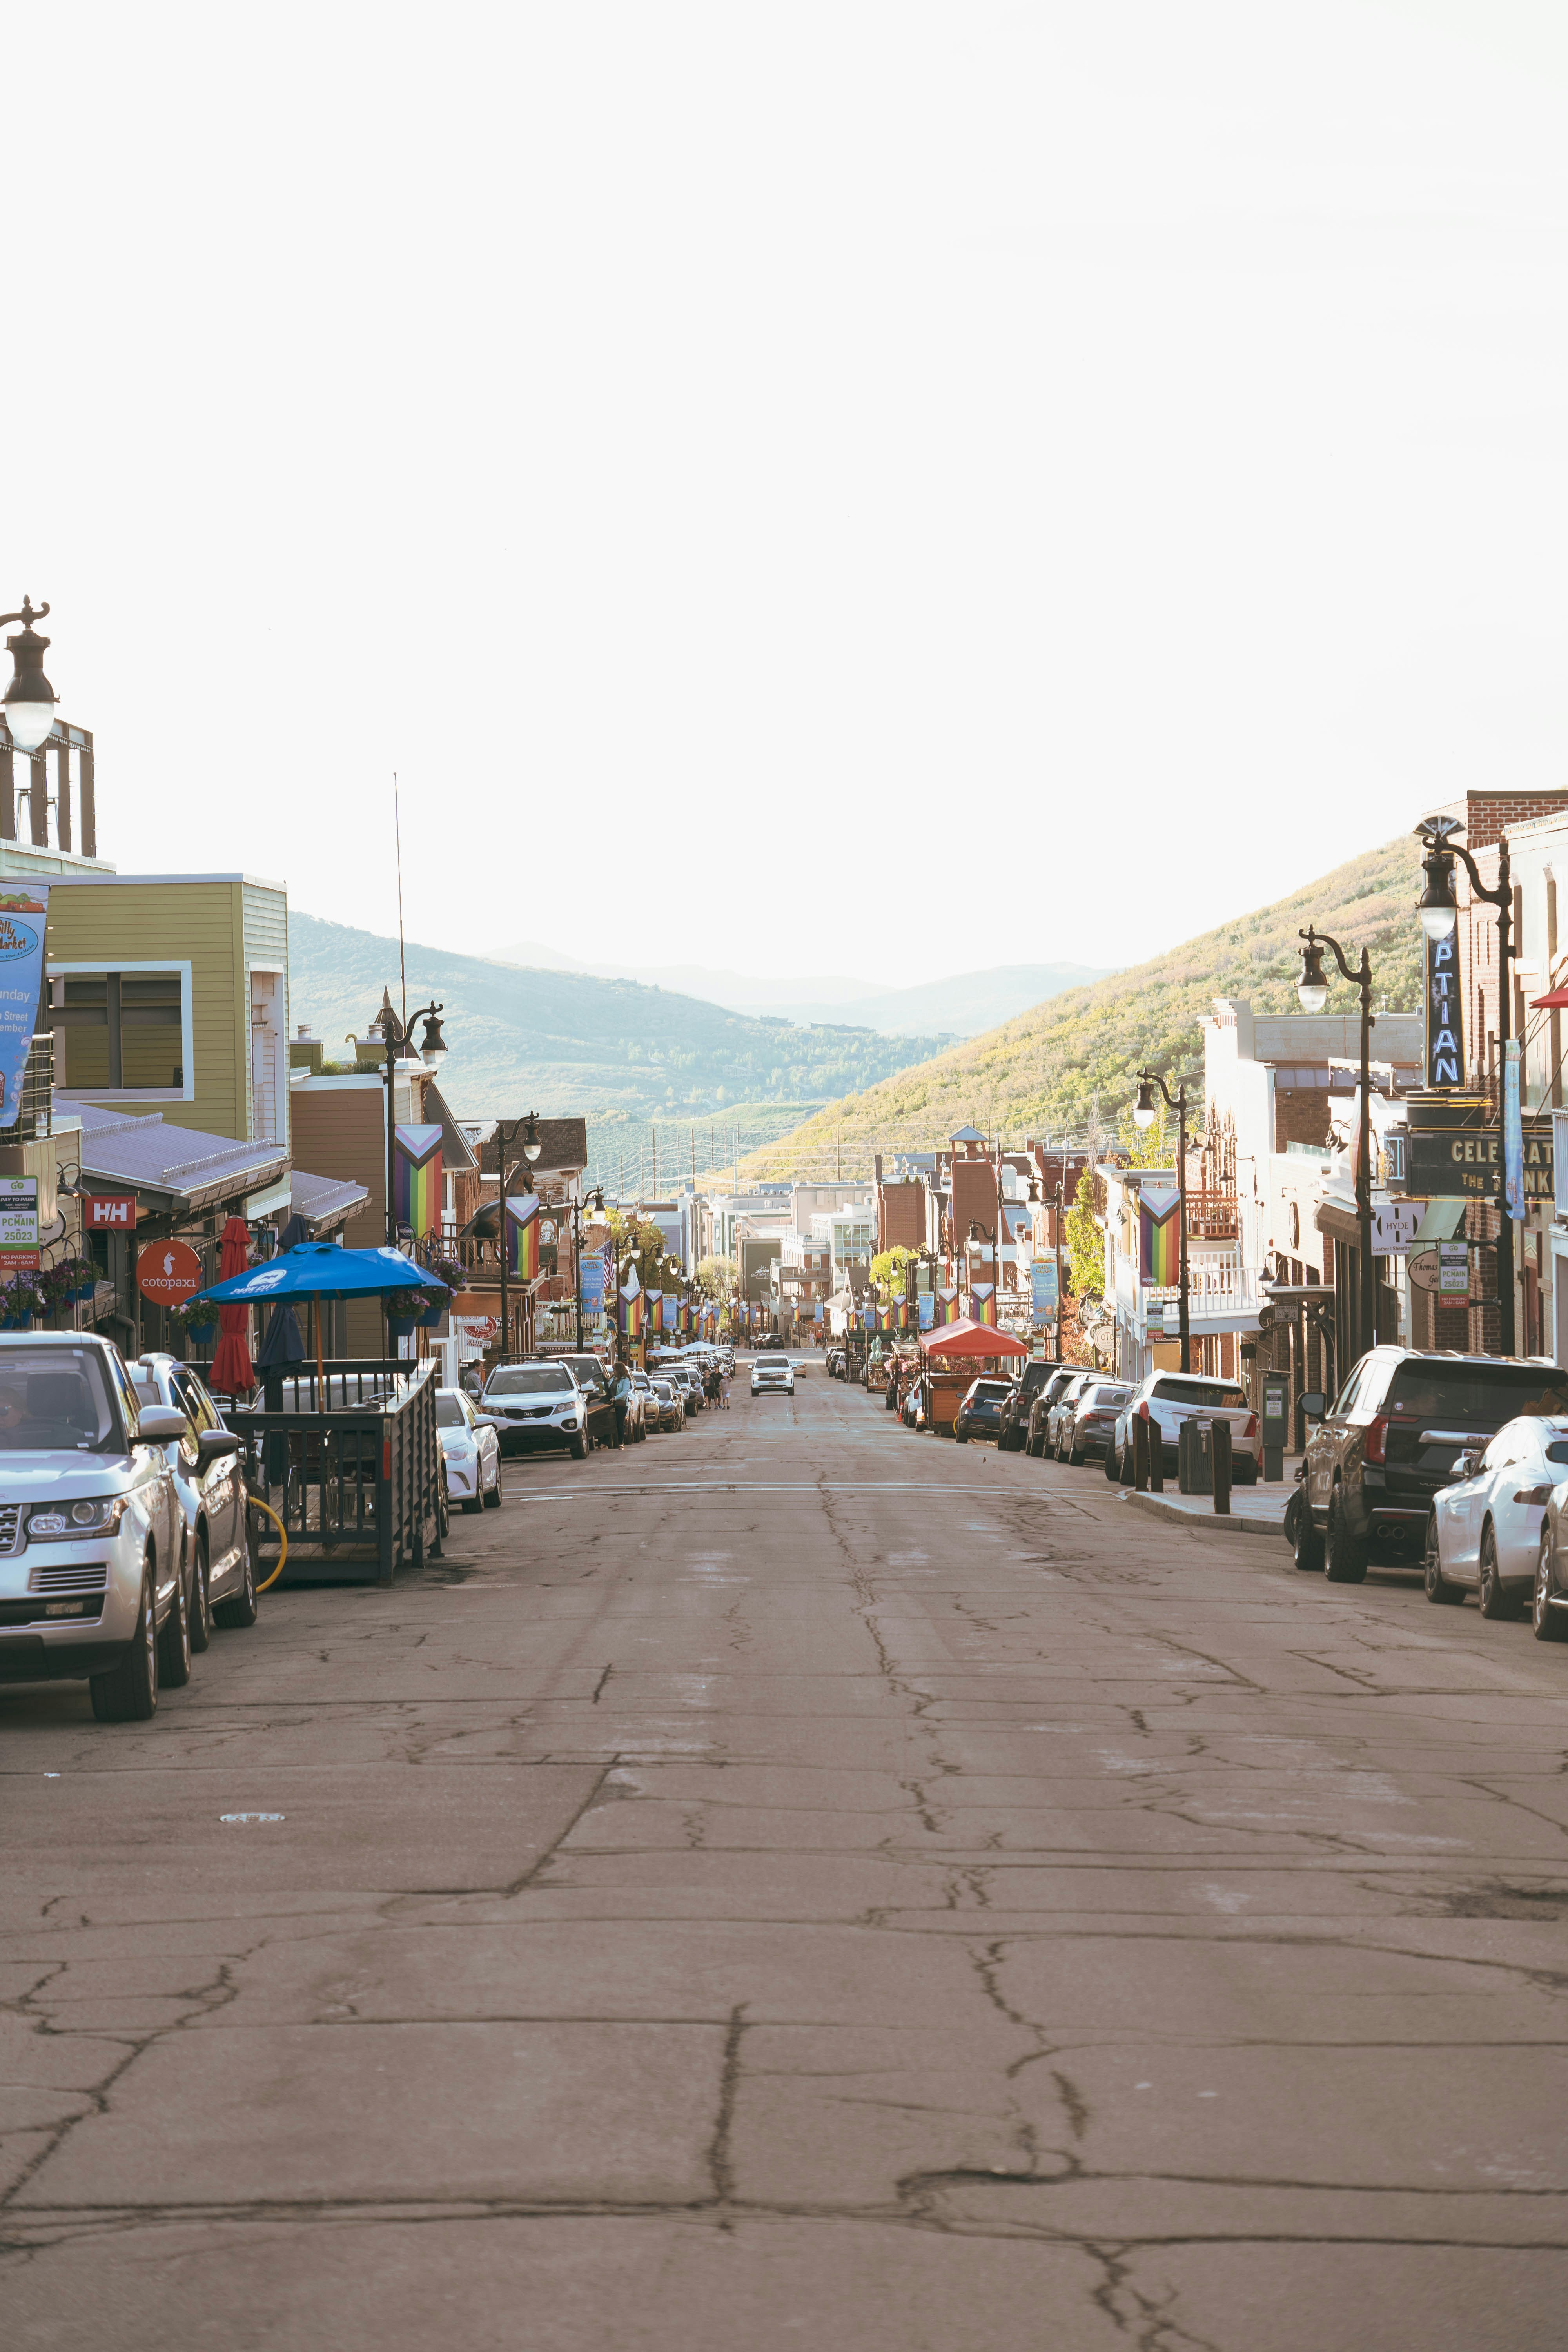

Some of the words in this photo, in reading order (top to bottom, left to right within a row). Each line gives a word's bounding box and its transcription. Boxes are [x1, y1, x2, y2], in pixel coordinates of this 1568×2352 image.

[4, 1011, 28, 1021] Street
[1462, 1172, 1484, 1189] THE
[2, 1218, 34, 1226] PCMAIN
[4, 1232, 32, 1241] 25023
[1413, 1259, 1437, 1271] Thomas
[142, 1278, 196, 1290] cotopaxi
[256, 1282, 281, 1291] CITY
[1101, 1332, 1114, 1341] OTC
